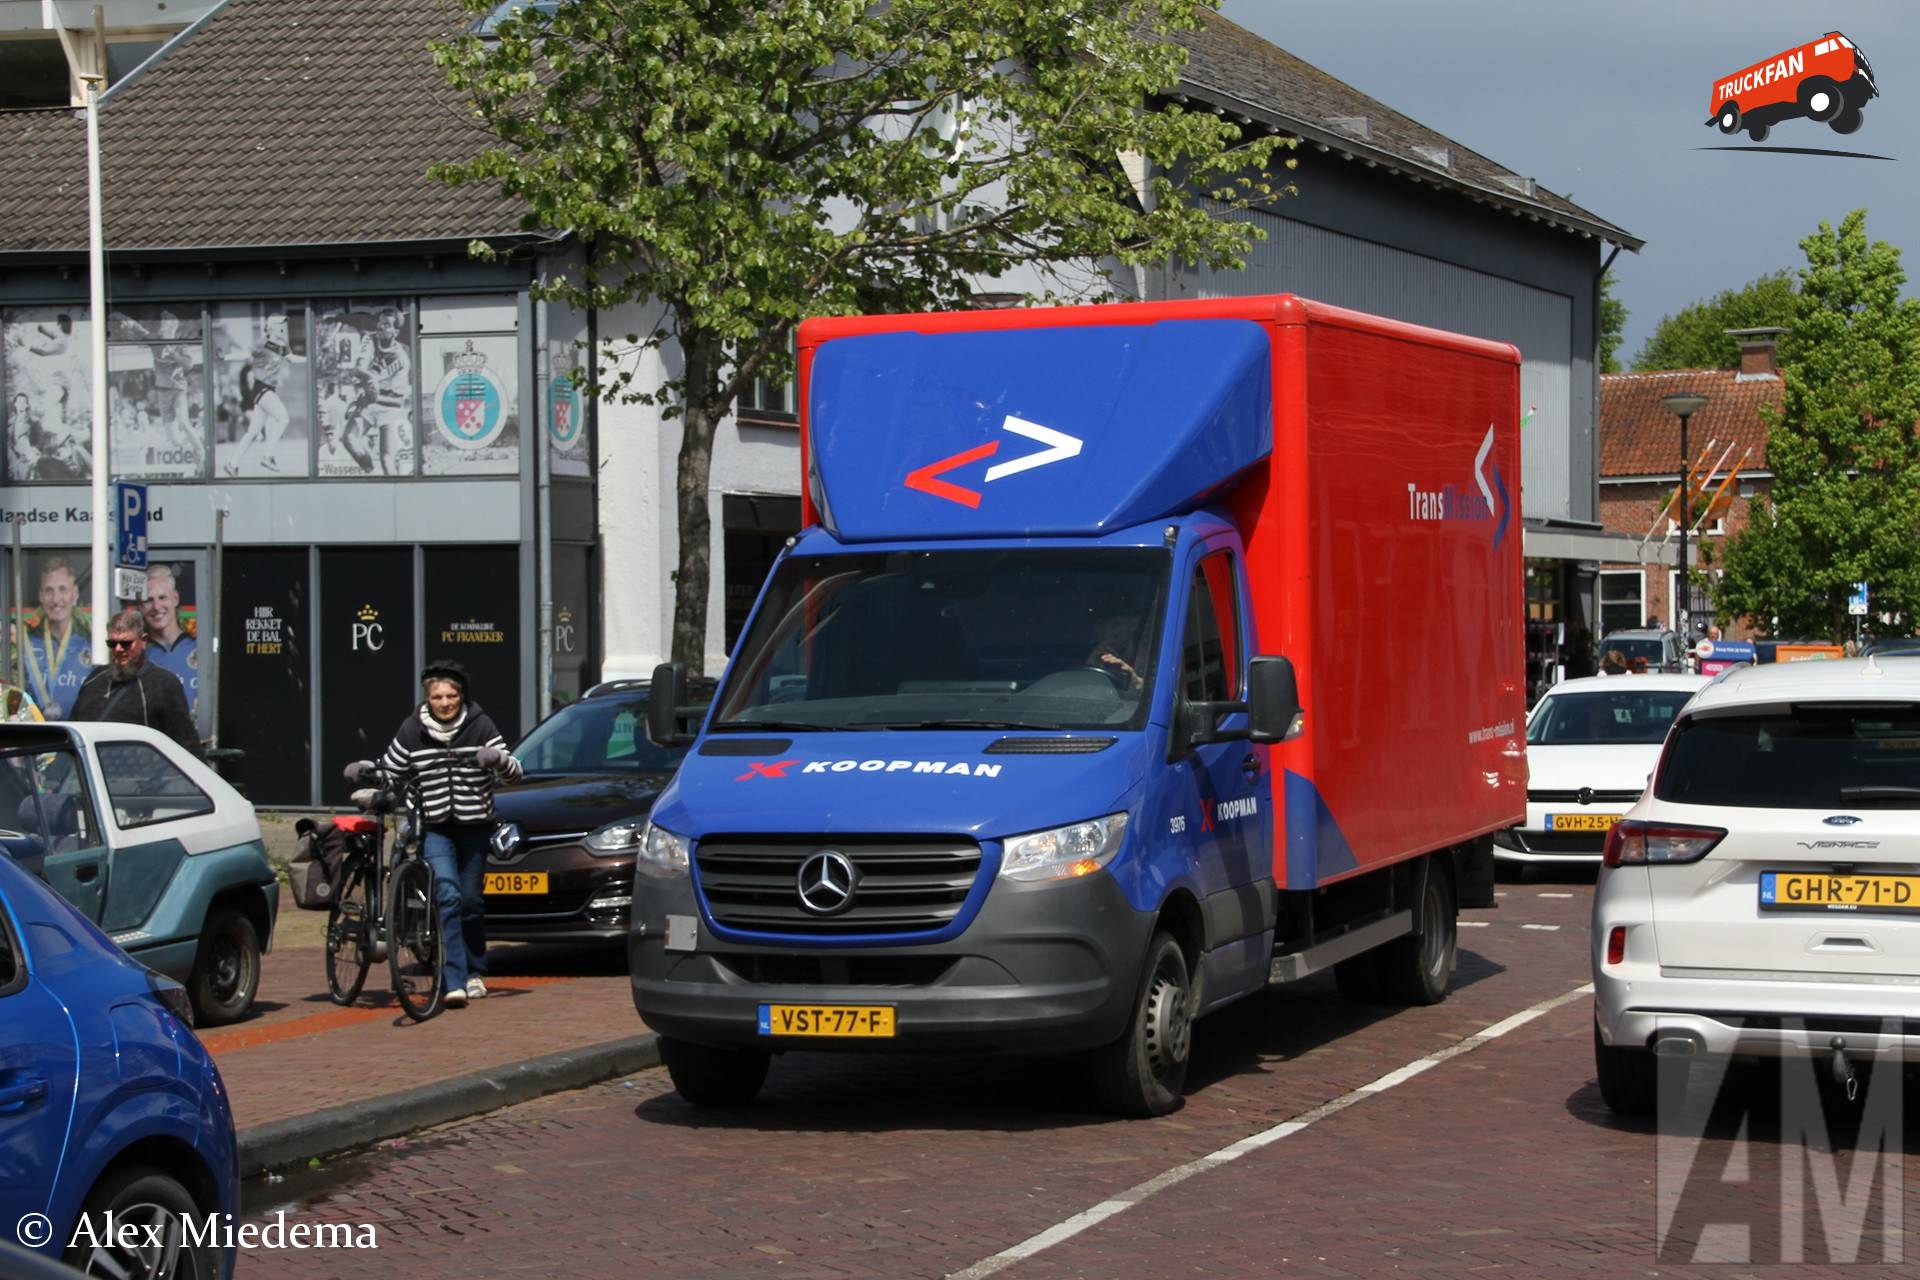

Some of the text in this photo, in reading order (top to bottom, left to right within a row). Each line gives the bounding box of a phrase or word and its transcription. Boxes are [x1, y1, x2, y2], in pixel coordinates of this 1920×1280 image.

[124, 488, 142, 532] P
[247, 630, 282, 642] DE BAL
[352, 622, 385, 651] PC
[556, 625, 575, 652] PC
[802, 760, 1002, 777] KOOPMAN
[1217, 796, 1257, 821] KOOPMAN
[1786, 878, 1911, 903] GHR-71-D
[781, 1009, 881, 1033] VST-77-F
